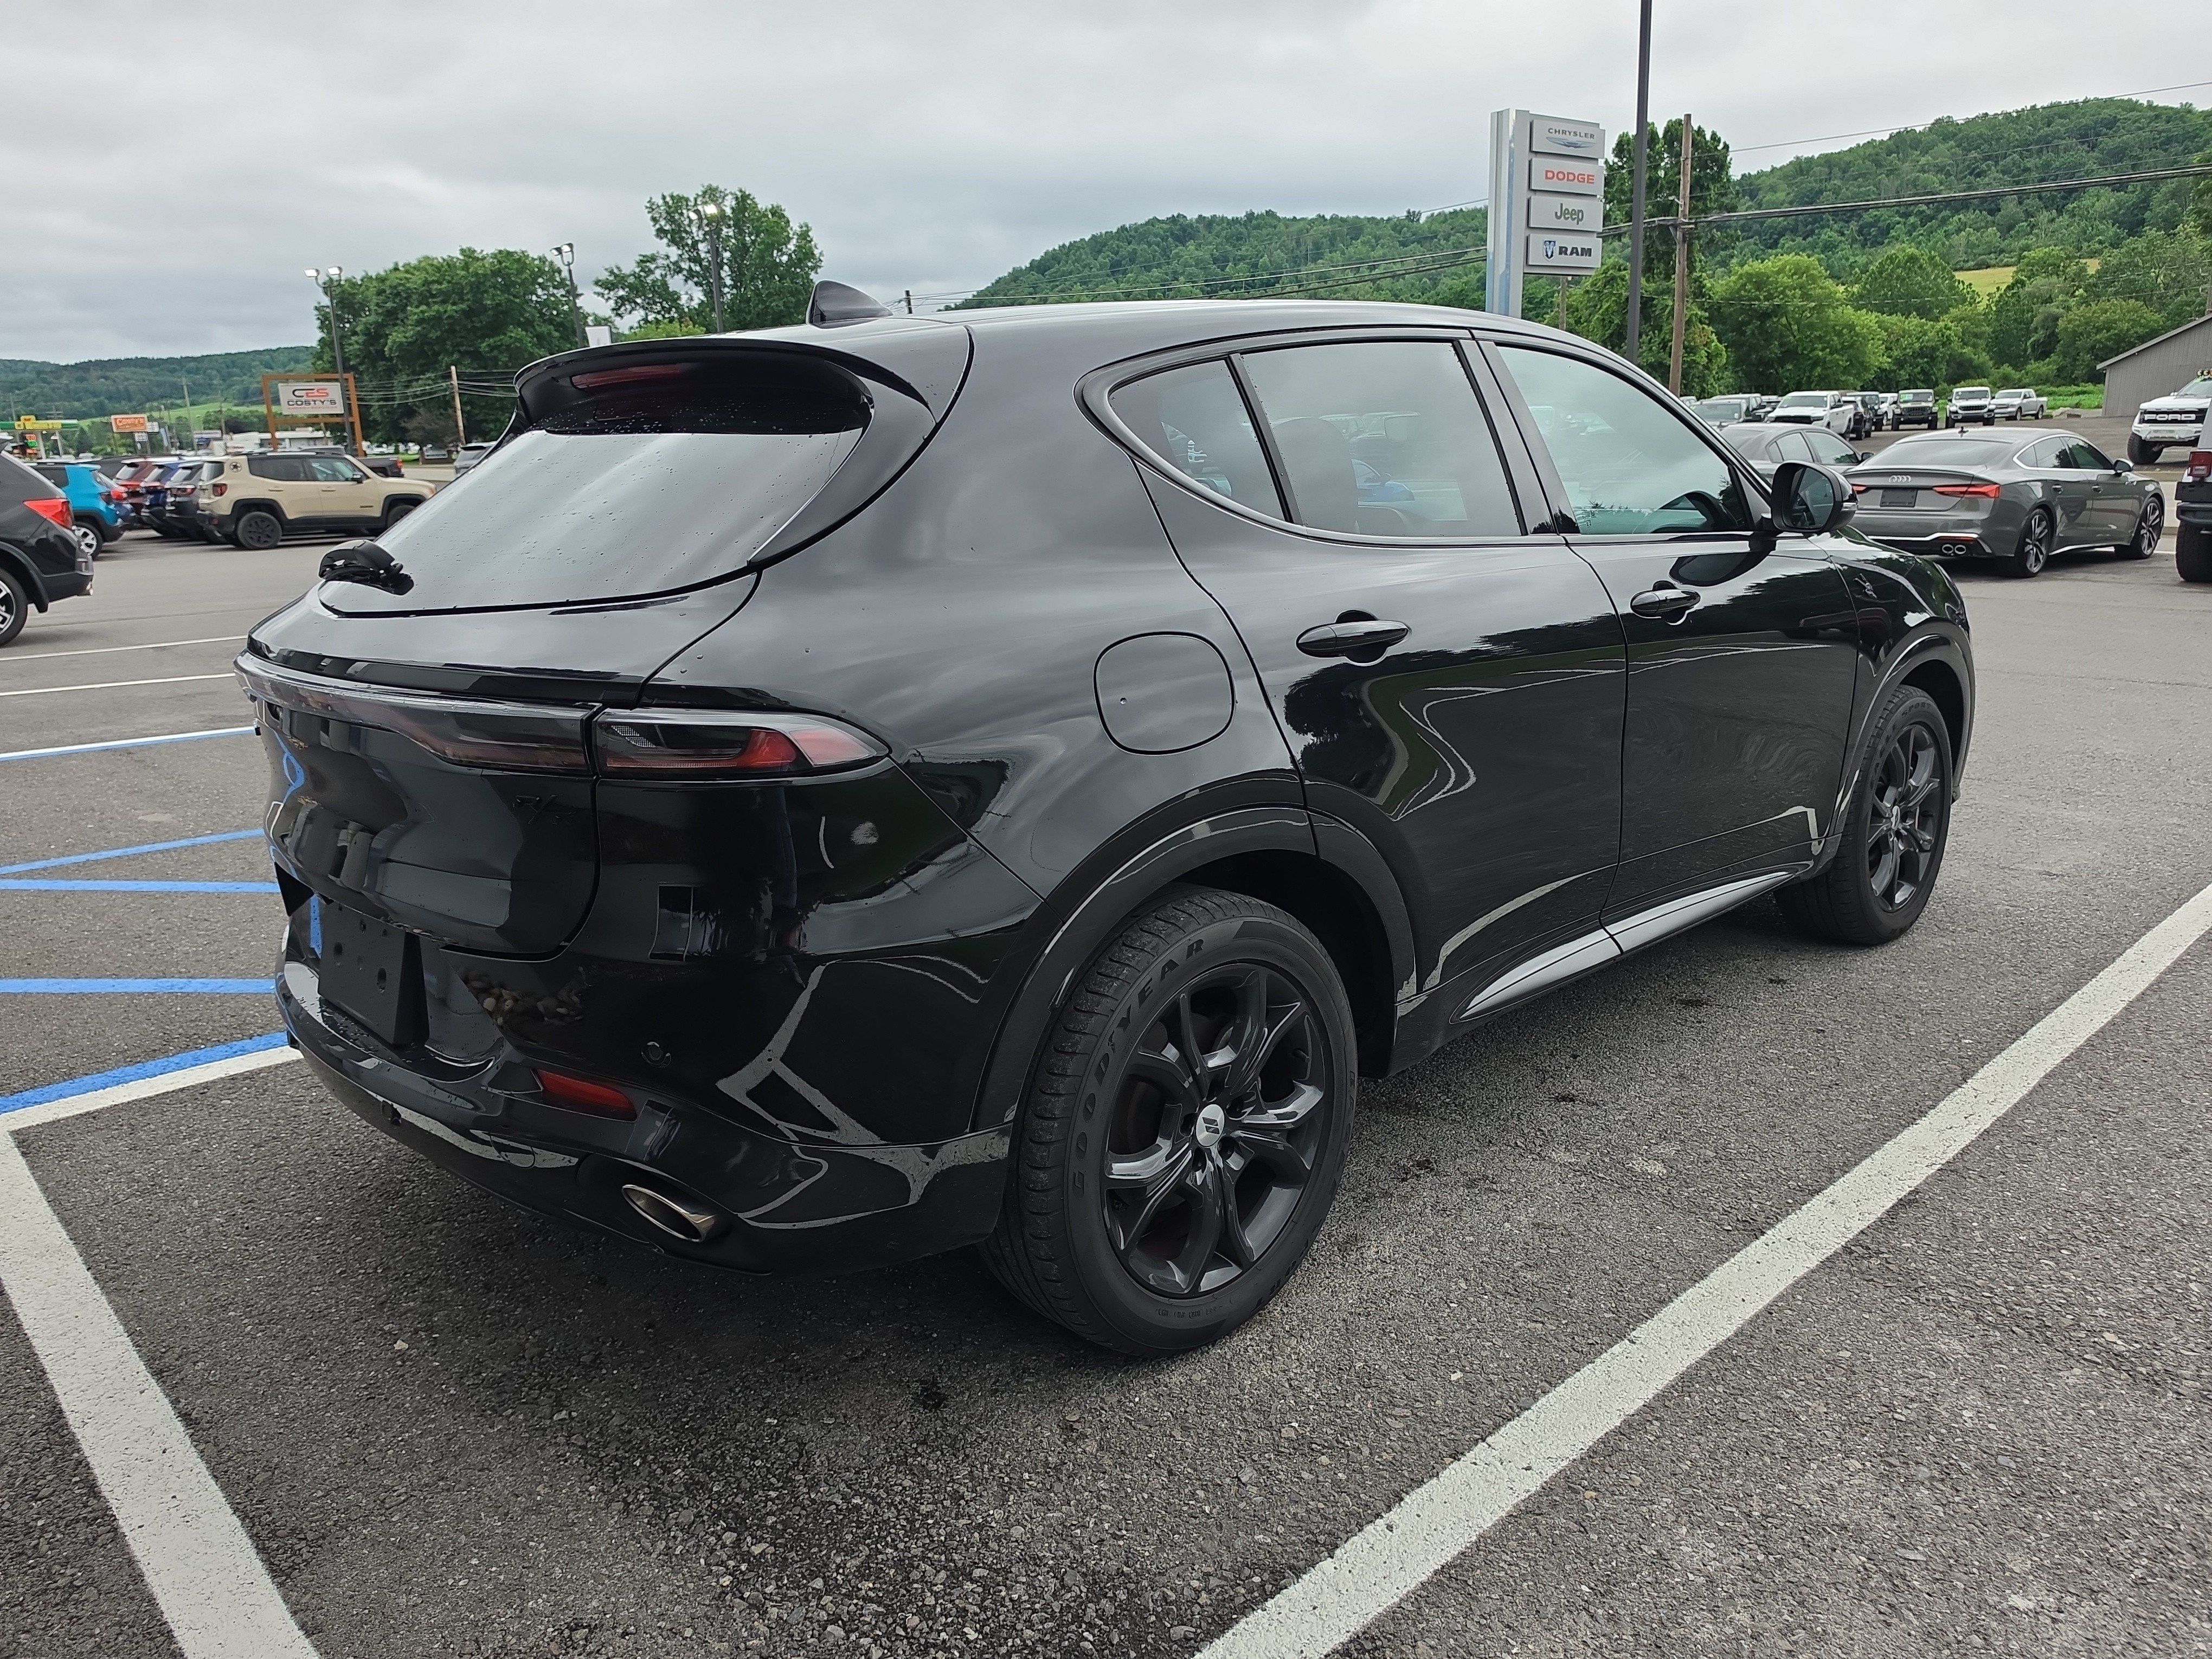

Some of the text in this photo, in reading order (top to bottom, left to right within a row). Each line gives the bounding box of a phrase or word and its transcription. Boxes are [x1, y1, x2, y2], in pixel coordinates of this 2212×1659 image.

[1547, 127, 1595, 140] CHRYSLER
[1545, 169, 1595, 184] DODGE
[1554, 203, 1584, 225] Jeep
[1558, 246, 1592, 257] RAM
[1072, 938, 1205, 1199] GOODYEAR
